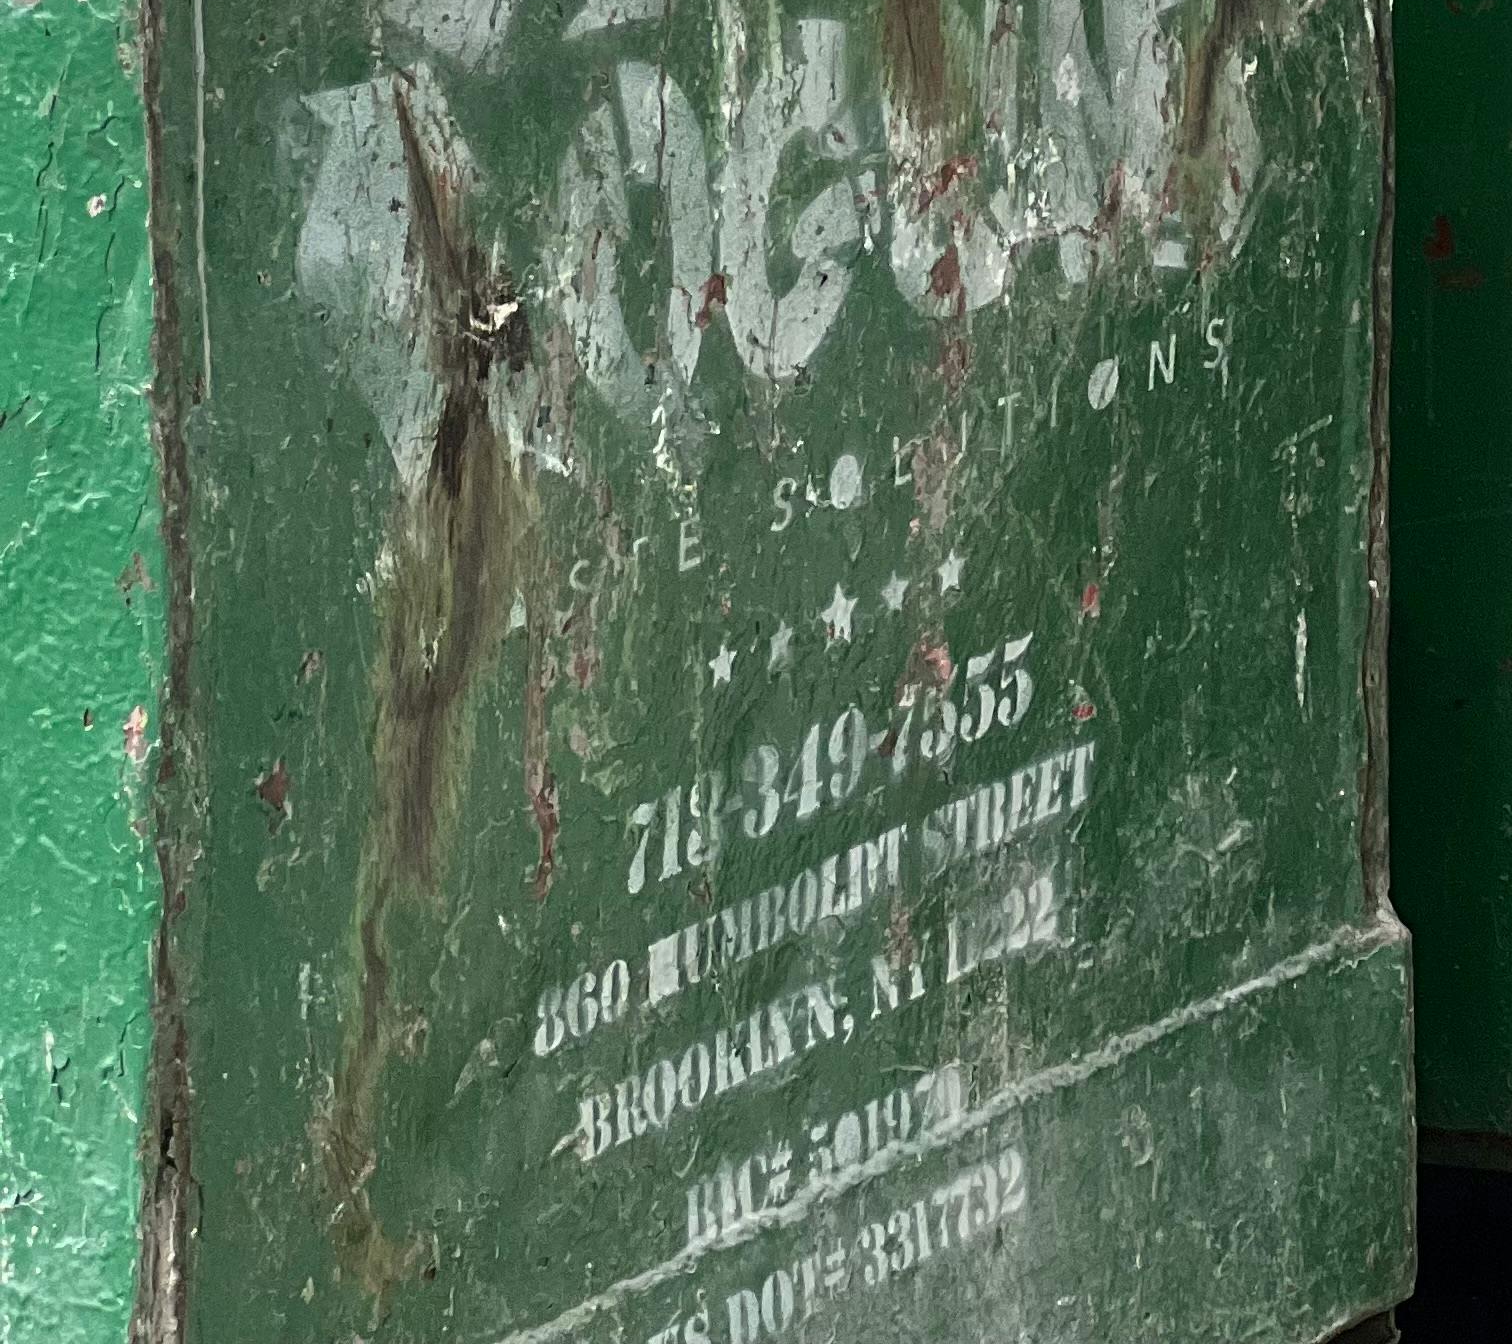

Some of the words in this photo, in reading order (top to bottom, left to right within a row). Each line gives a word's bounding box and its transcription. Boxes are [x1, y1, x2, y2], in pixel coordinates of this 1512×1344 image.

[534, 959, 631, 1057] 860
[923, 740, 1096, 859] STREET
[579, 984, 855, 1162] BROOKLYN,
